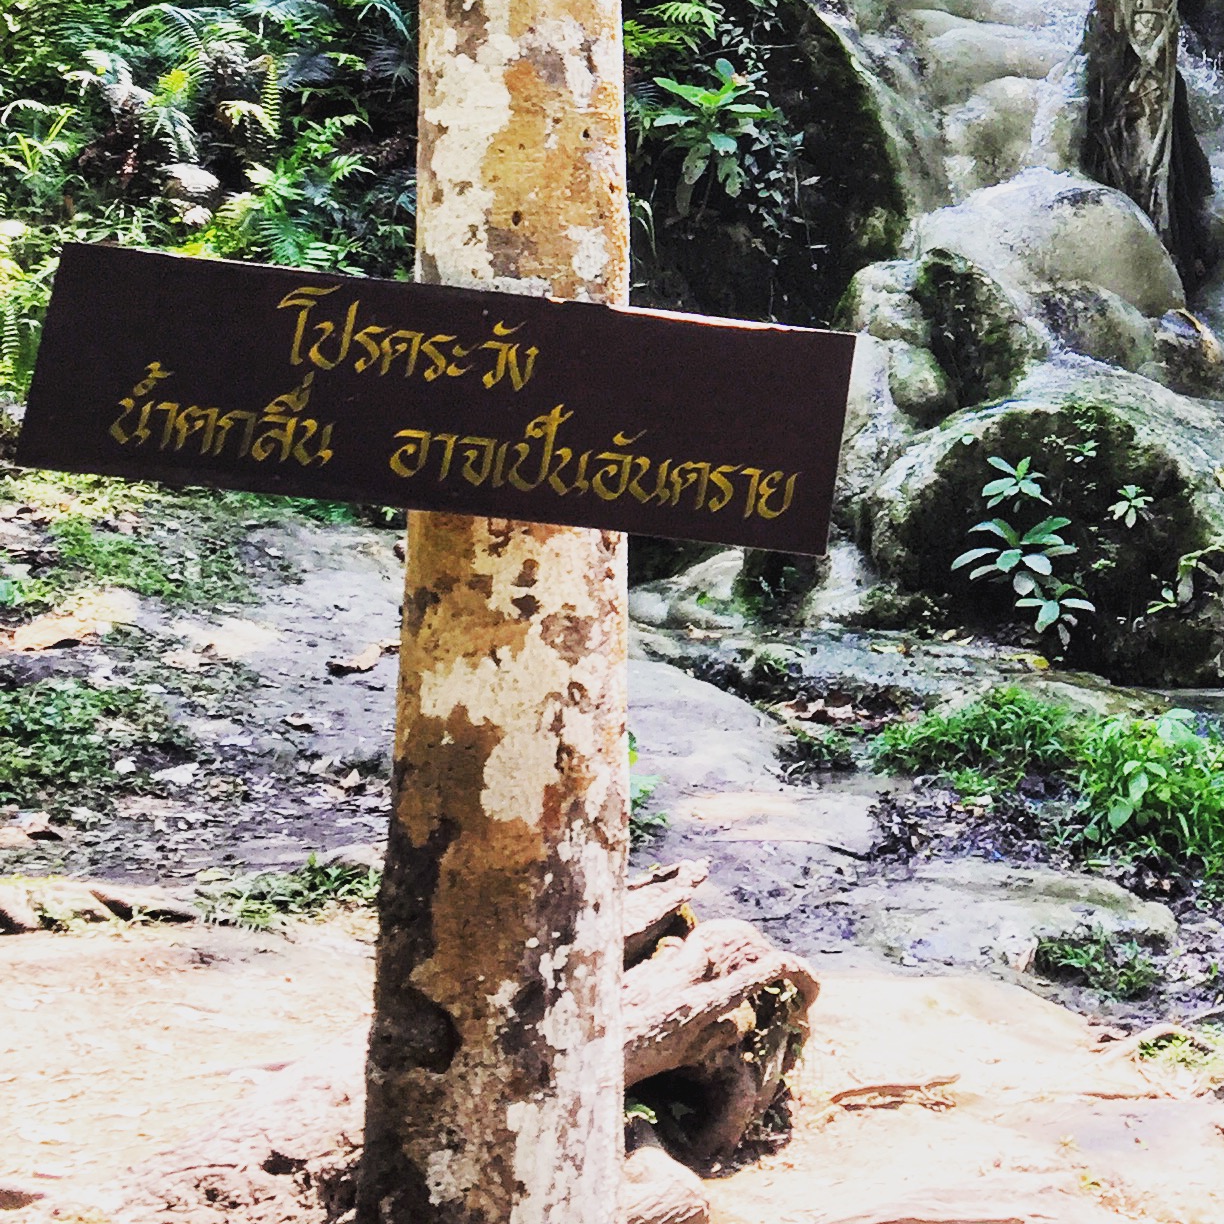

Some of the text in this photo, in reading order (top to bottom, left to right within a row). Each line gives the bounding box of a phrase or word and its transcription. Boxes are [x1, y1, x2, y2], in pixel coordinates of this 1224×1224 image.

[276, 283, 540, 393] โปรดระวัง
[109, 361, 801, 521] น้ำตกลื่น อาจเป็นอันตราย
